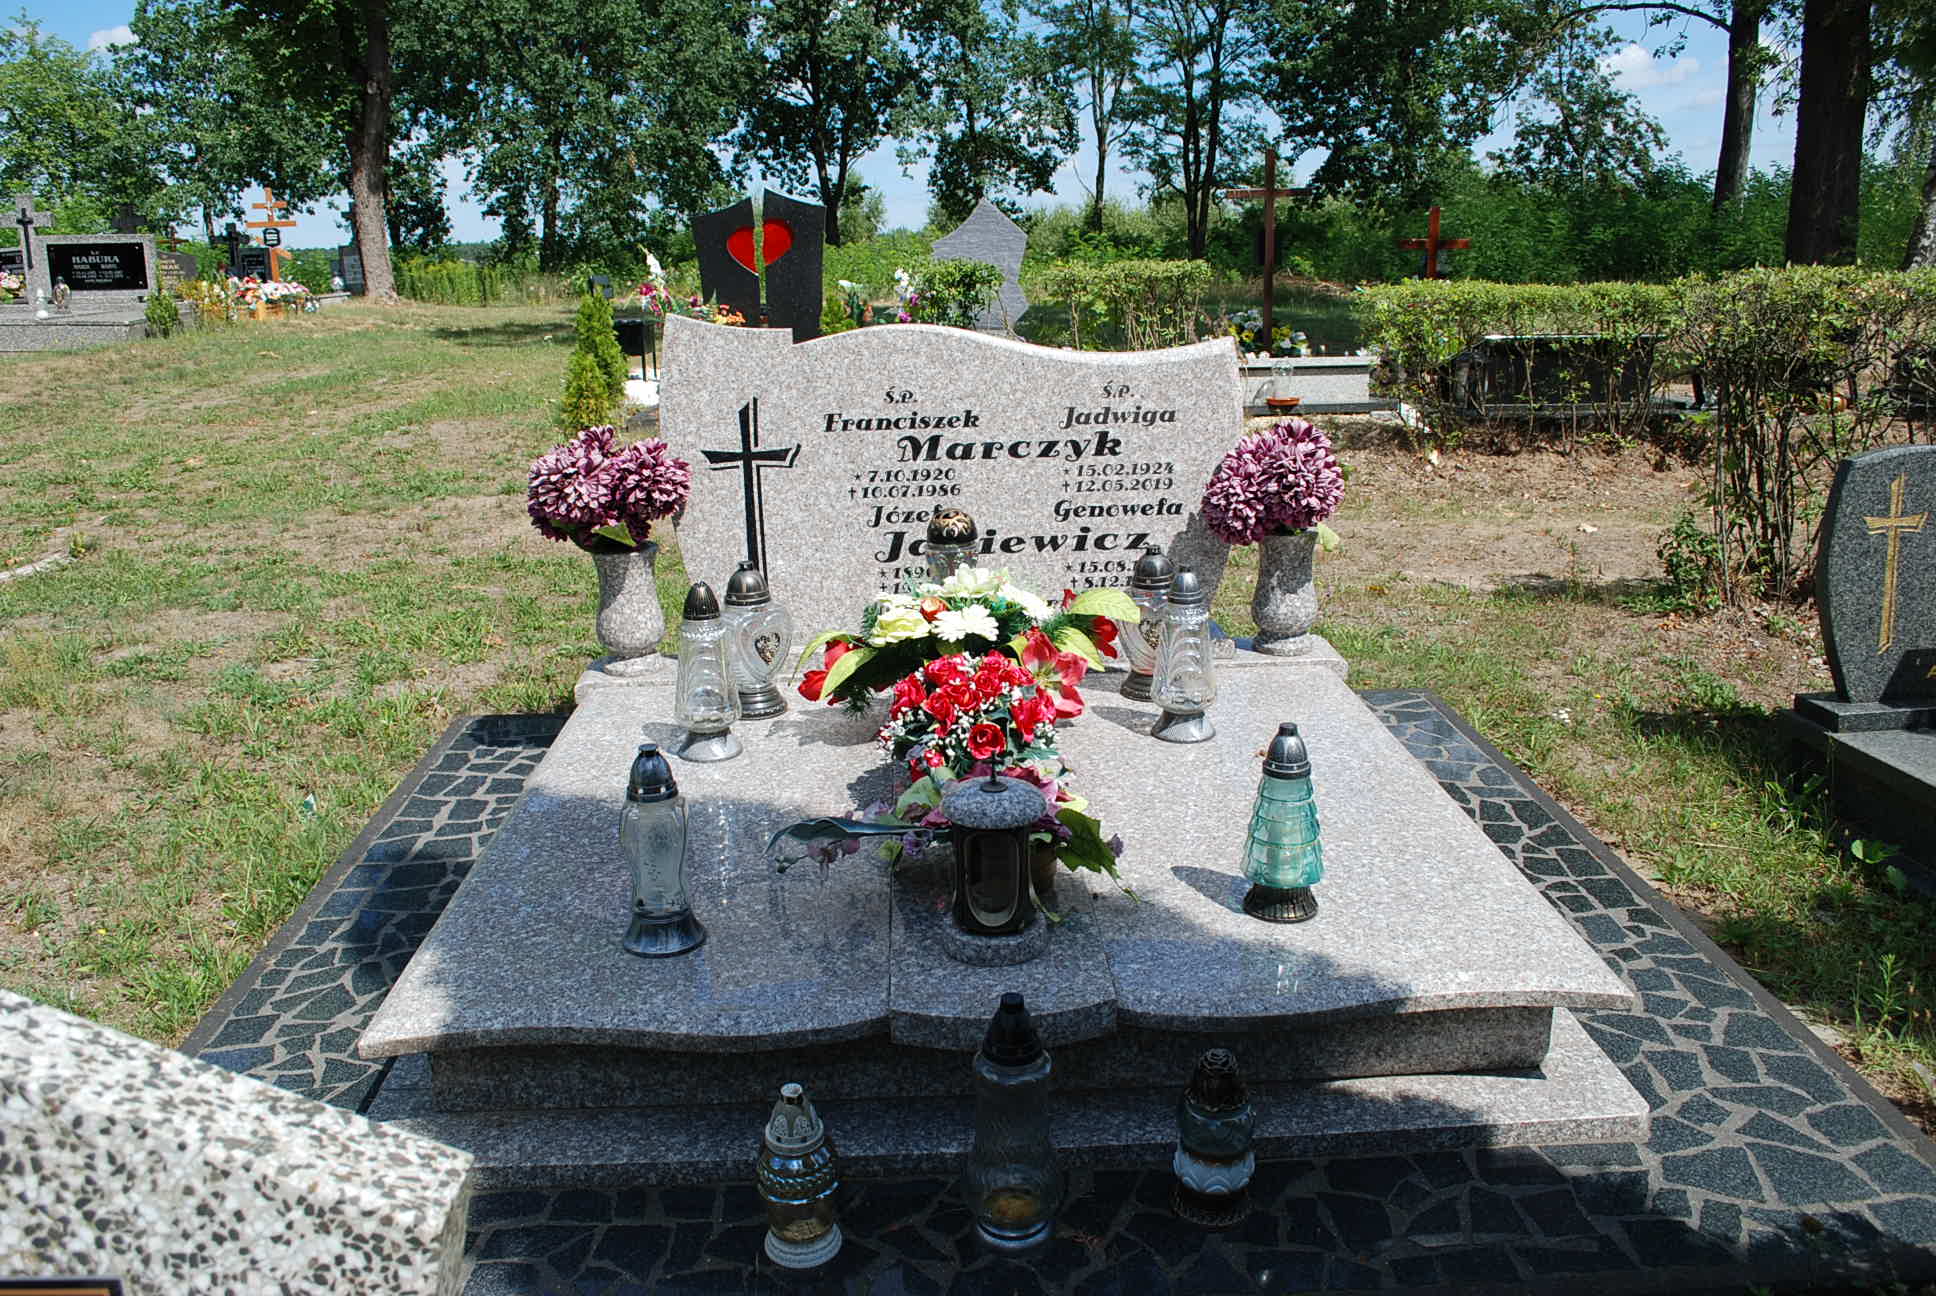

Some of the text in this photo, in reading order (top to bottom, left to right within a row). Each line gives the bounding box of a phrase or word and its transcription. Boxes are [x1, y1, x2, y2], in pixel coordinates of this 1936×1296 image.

[823, 410, 980, 433] Franciszek
[1058, 406, 1177, 430] Jadwiga
[897, 431, 1122, 463] Marczyk
[868, 468, 956, 483] 7.10.1920
[1075, 478, 1174, 493] 12.05.2019
[861, 484, 961, 499] 10.07.1986
[1054, 498, 1184, 522] Genowefa
[875, 527, 1152, 563] Jaiewicz
